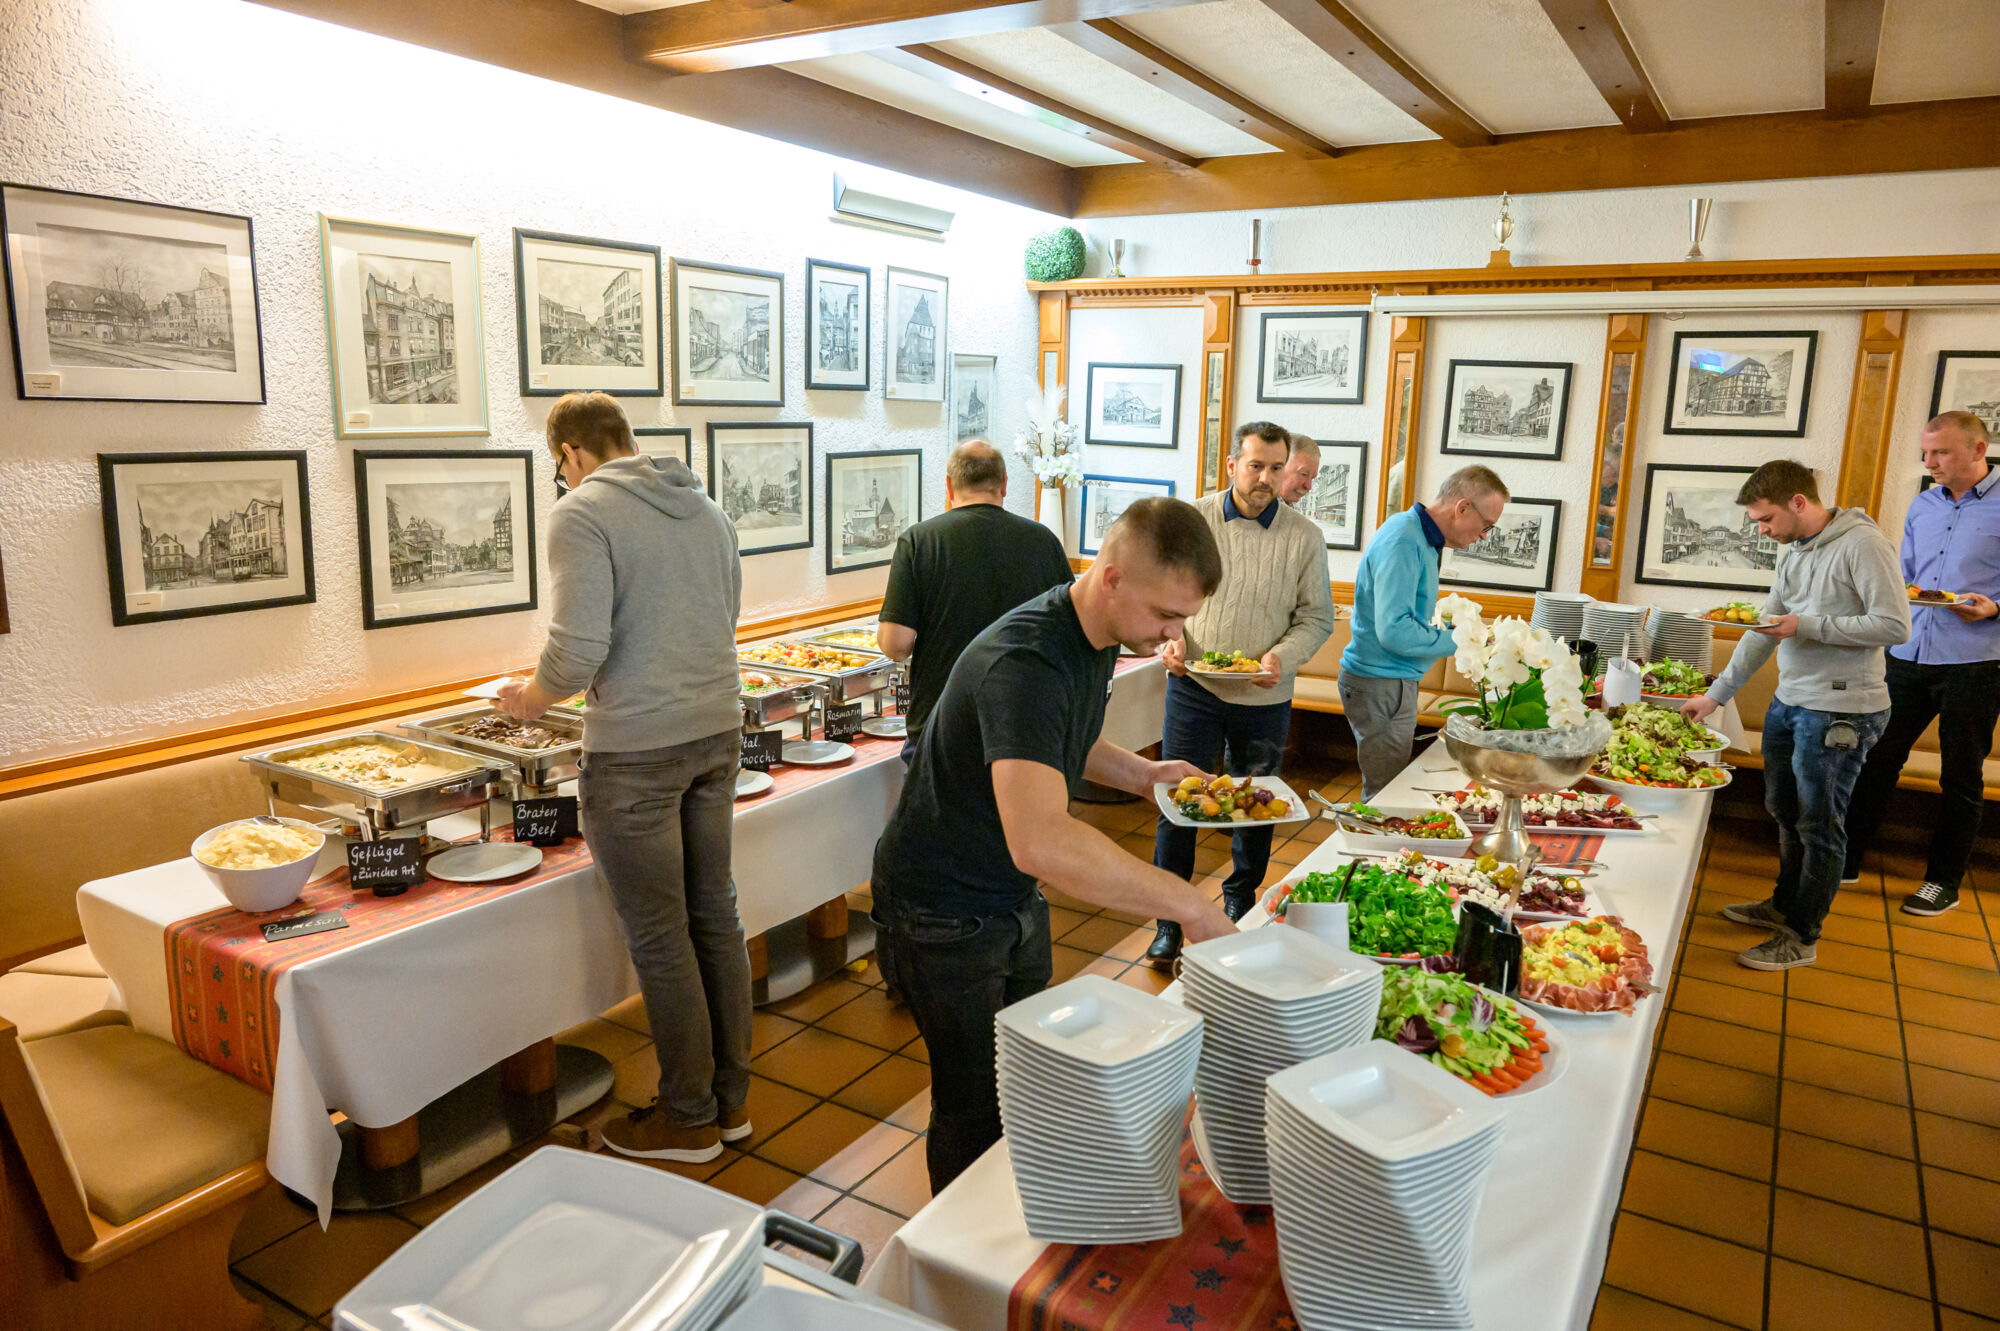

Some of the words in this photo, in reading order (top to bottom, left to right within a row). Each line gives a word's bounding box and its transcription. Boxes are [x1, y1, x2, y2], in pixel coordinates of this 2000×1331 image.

[516, 804, 558, 820] Braten
[517, 827, 525, 837] v.
[527, 820, 557, 837] Beef
[351, 843, 405, 866] Geflügel
[264, 917, 343, 937] Parmesan
